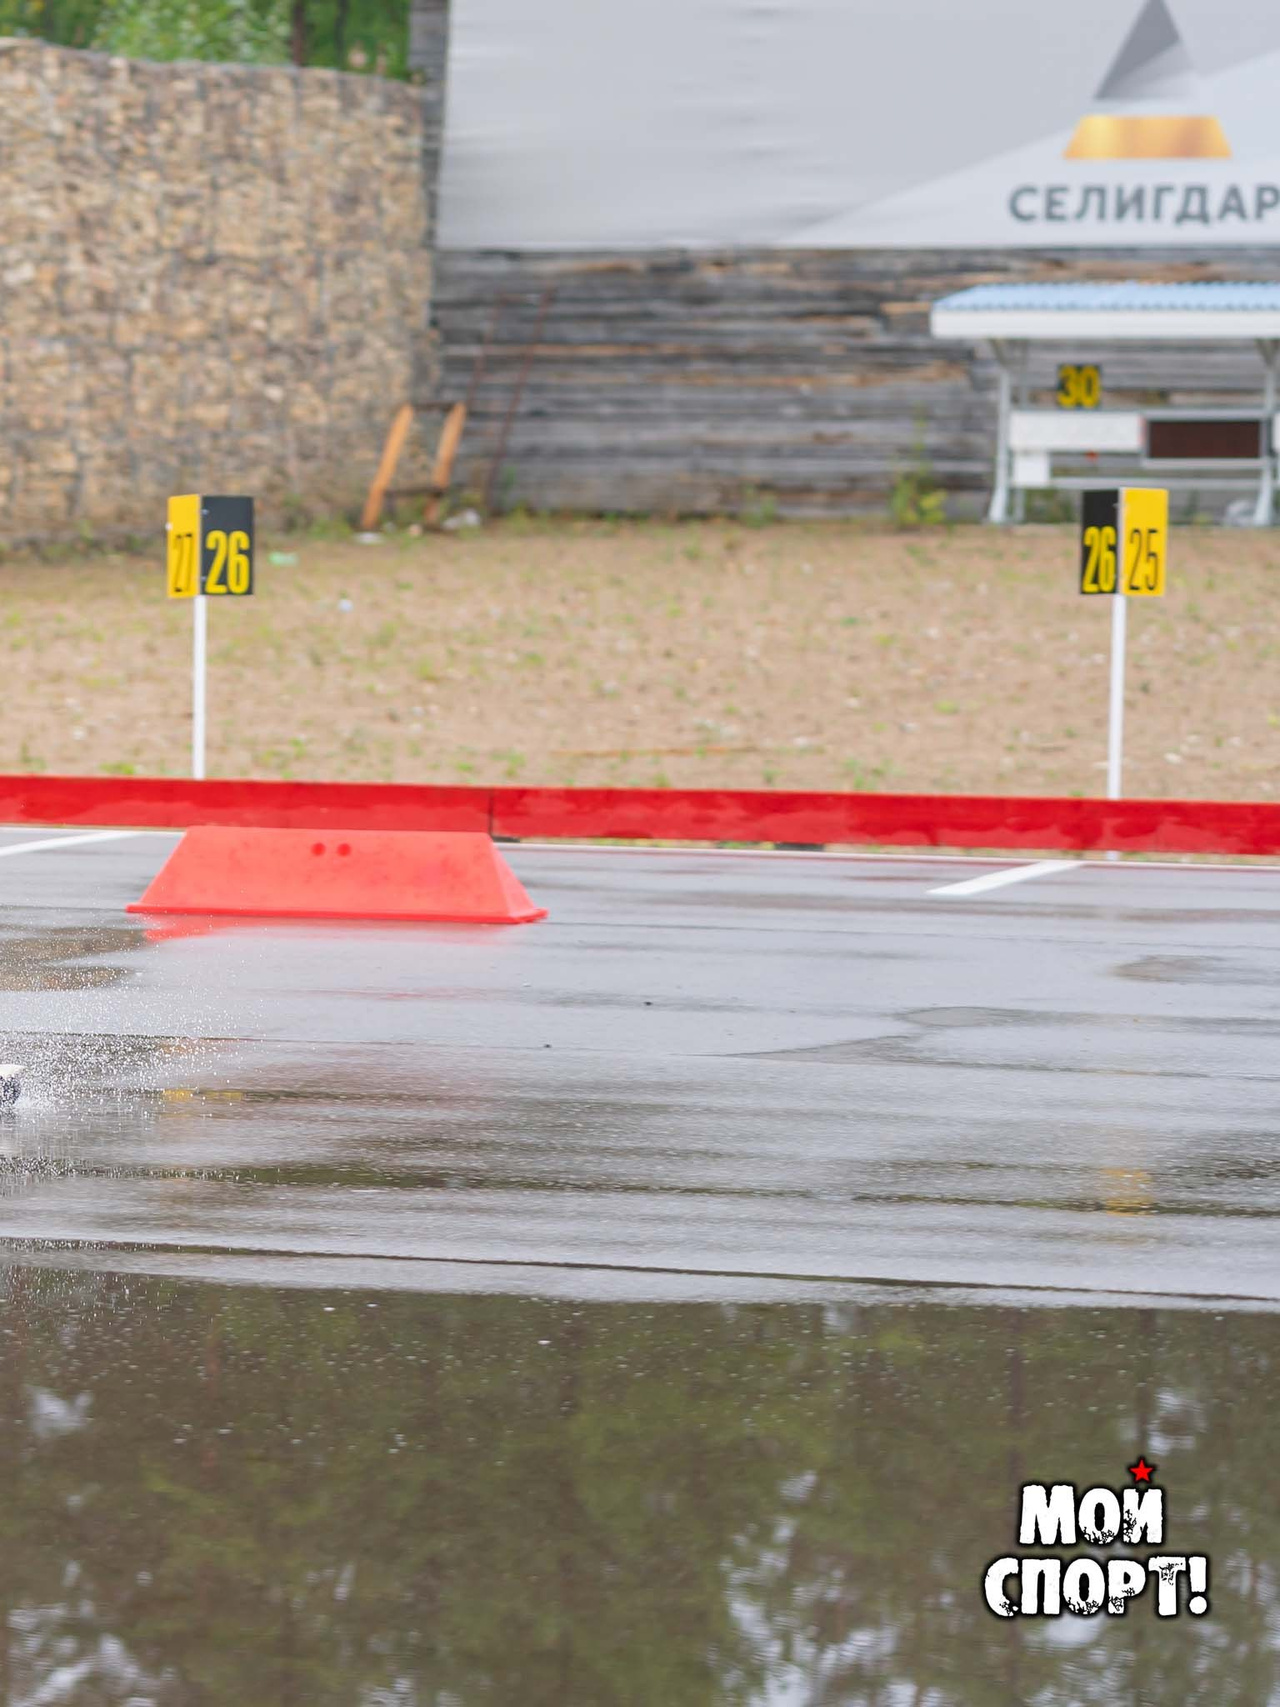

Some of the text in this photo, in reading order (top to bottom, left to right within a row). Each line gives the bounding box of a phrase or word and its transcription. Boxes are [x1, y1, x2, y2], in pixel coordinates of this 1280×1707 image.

[1008, 183, 1280, 225] СЕЛИГДАР
[1056, 364, 1101, 409] 30
[204, 529, 250, 594] 26
[1082, 525, 1117, 593] 26
[1128, 528, 1158, 591] 25
